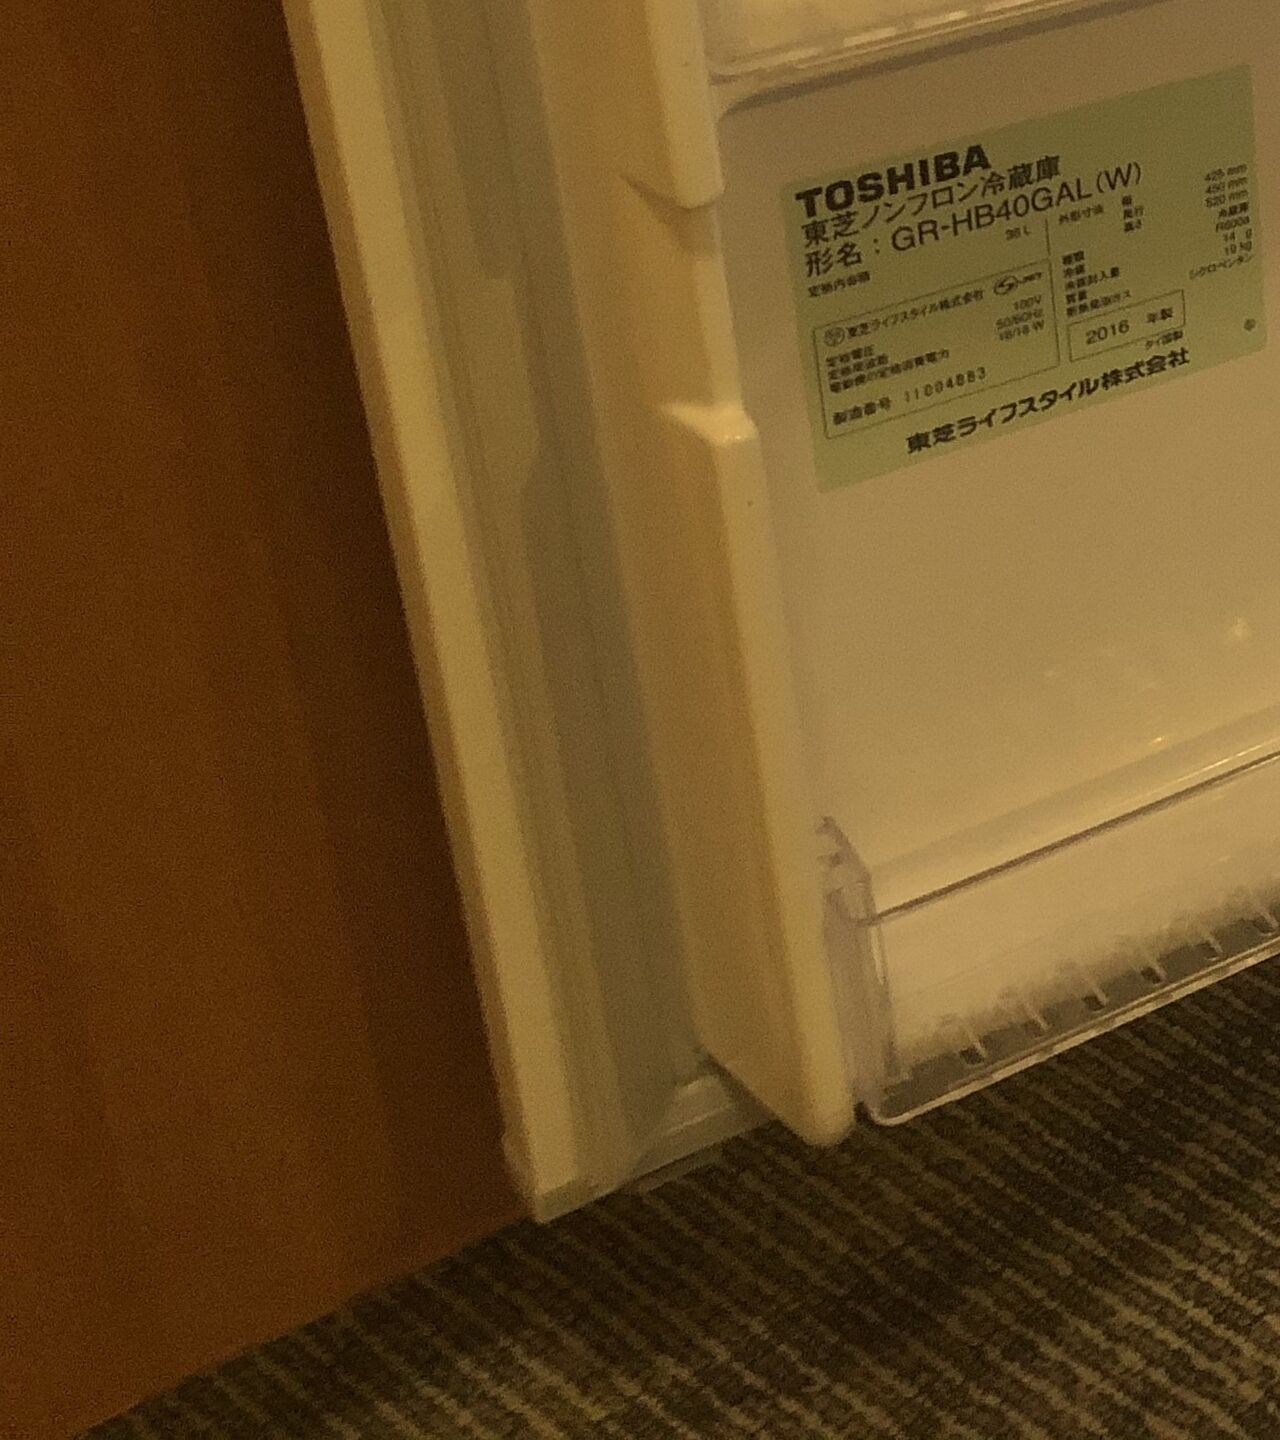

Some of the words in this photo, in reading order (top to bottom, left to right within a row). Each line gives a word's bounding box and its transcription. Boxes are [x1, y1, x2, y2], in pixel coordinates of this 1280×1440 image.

[794, 142, 990, 220] TOSHIBA
[801, 154, 1062, 248] 東芝ノンフロン冷蔵庫
[905, 346, 1189, 455] 東芝ライフスタイル株式会社
